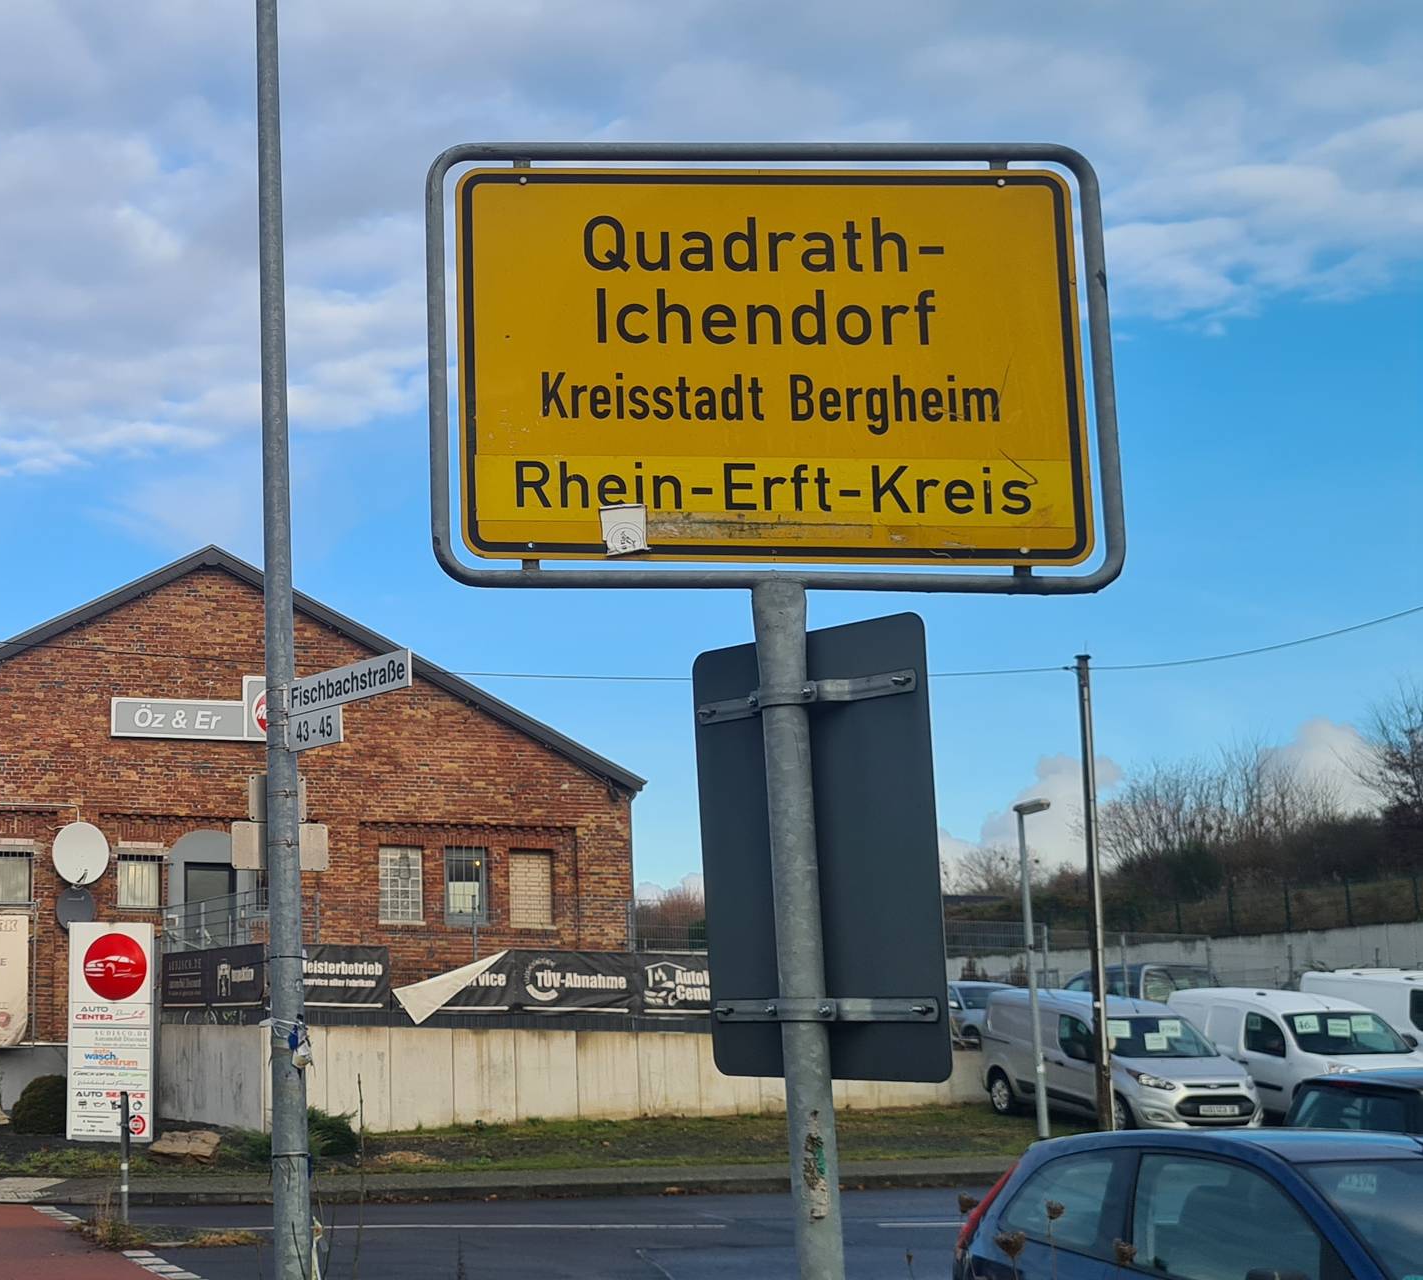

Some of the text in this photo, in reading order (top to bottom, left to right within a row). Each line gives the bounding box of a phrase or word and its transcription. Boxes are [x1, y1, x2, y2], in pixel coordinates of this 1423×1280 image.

[583, 215, 945, 273] Quadrath-
[596, 287, 936, 346] Ichendorf
[541, 371, 1001, 436] Kreisstadt Bergheim
[515, 460, 1033, 515] Rhein-Erft-Kreis
[291, 660, 405, 708] Fischbachstraße
[134, 704, 222, 730] Öz & Er
[296, 720, 310, 742] 43
[318, 715, 333, 738] 45
[535, 969, 627, 990] TÜV-Abnahme
[84, 1052, 117, 1060] wasch
[98, 1059, 138, 1067] centrum
